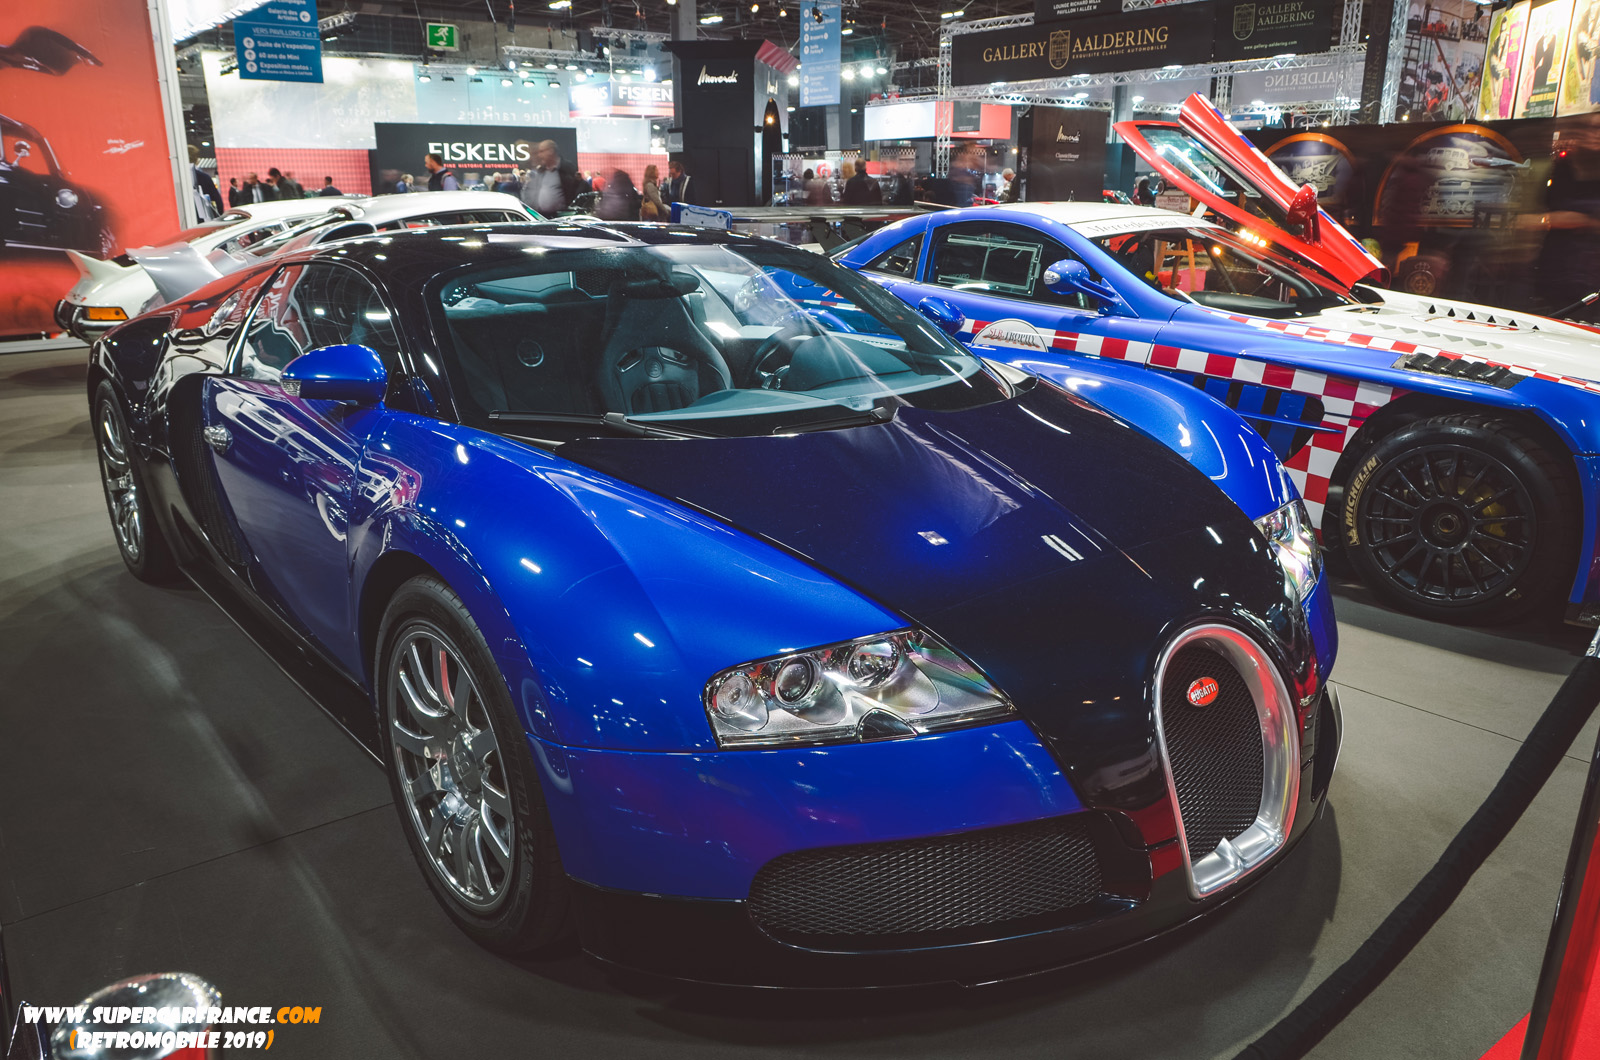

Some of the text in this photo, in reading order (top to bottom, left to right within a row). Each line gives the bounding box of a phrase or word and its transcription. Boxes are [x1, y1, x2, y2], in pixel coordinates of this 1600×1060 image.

[1258, 2, 1304, 15] GALLERY
[1257, 10, 1315, 26] AALDERING
[269, 28, 301, 37] PAVILLONS
[983, 26, 1169, 63] GALLERY AALDERING
[1127, 44, 1167, 53] AUTOMOBILES
[1244, 41, 1297, 49] www.gallery-aaldering.com
[428, 142, 530, 161] FISKENS
[1346, 457, 1377, 527] MICHELIN
